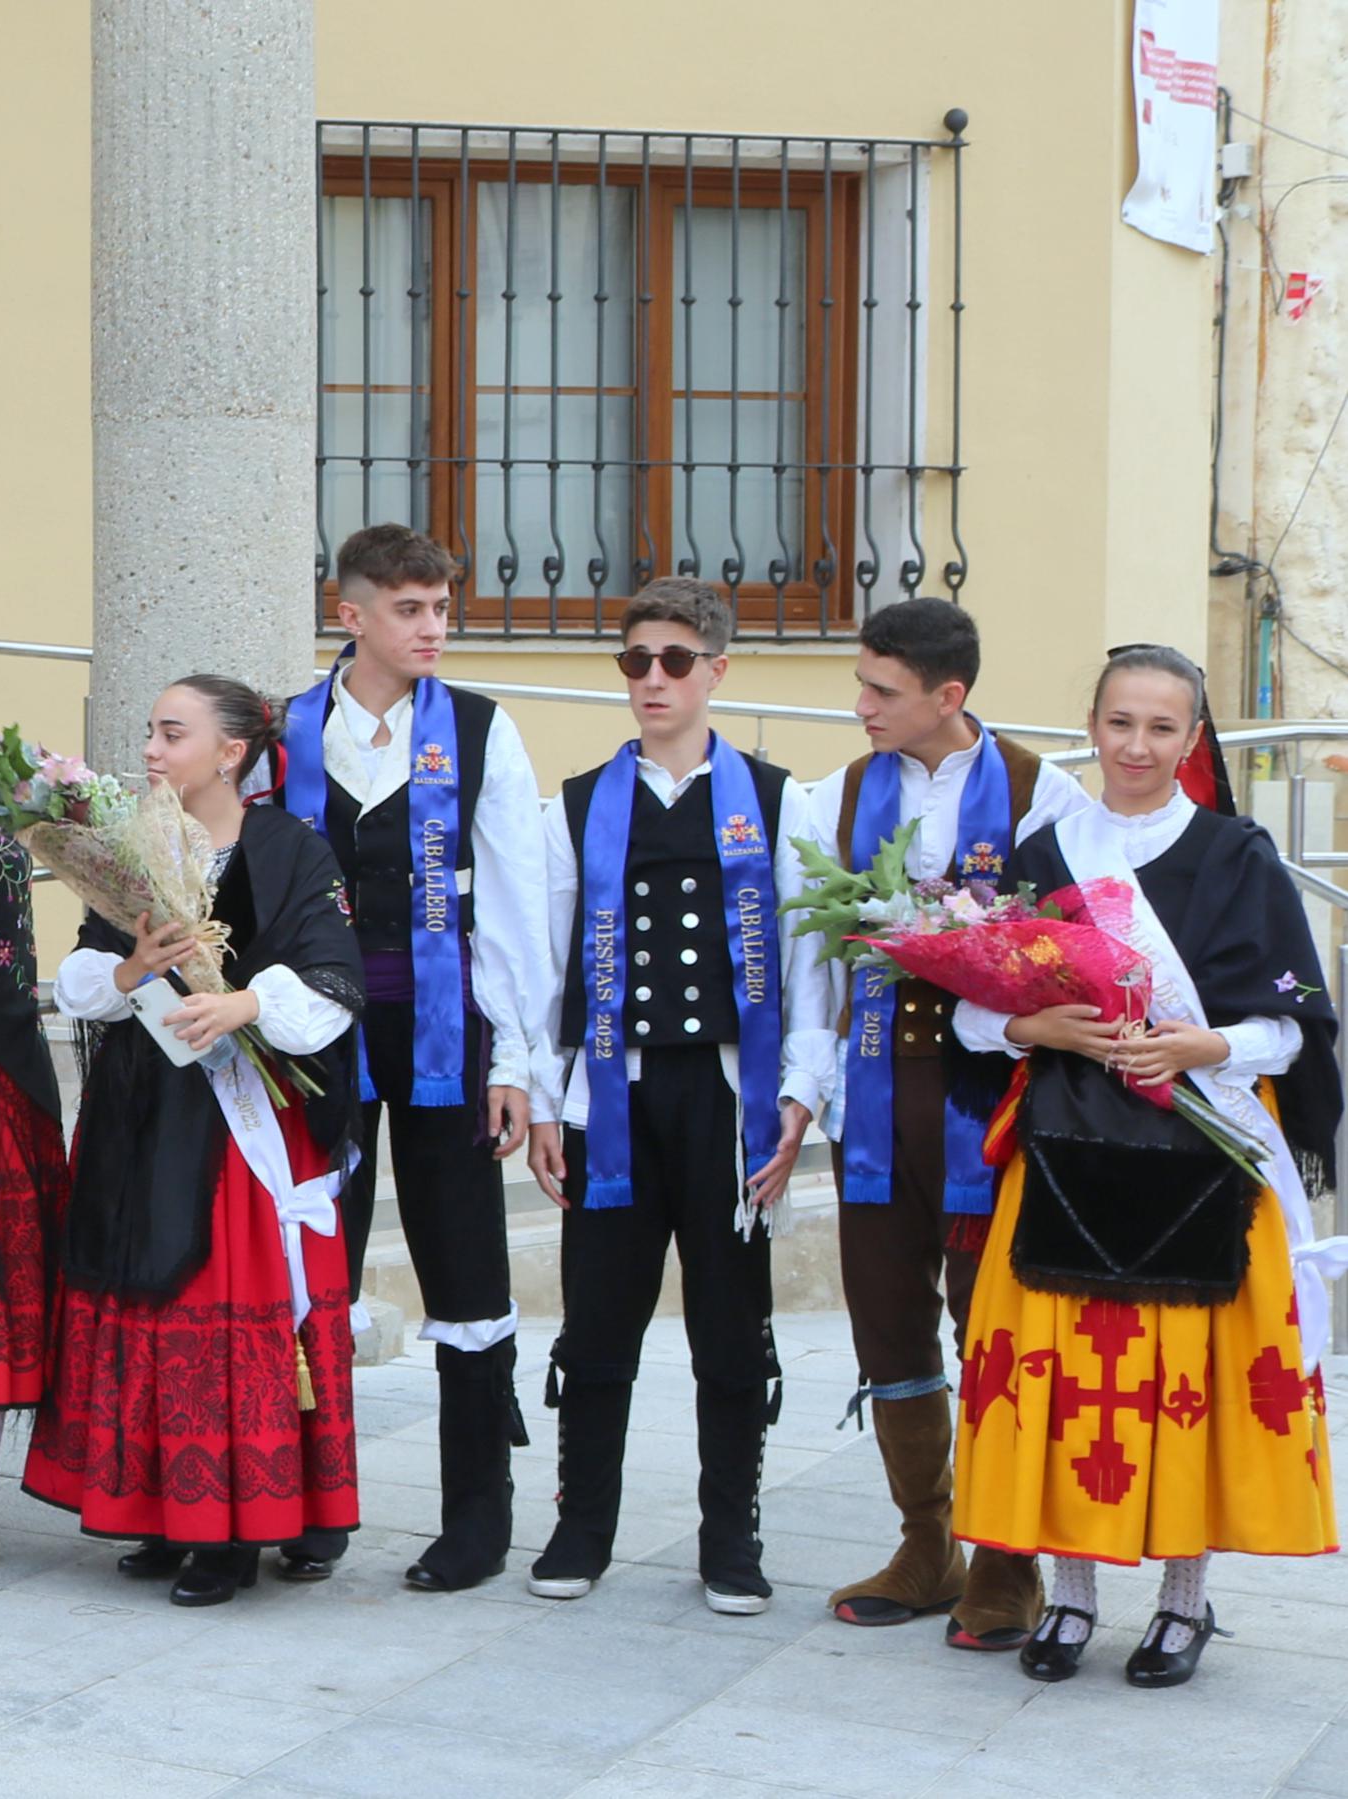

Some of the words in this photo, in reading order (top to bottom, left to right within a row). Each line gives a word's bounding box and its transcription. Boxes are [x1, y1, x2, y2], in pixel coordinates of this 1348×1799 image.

[423, 819, 447, 933] CABALLERO
[595, 909, 614, 1002] FIESTAS
[737, 887, 765, 1004] CABALLERO
[1153, 978, 1181, 1010] DE
[595, 1013, 612, 1060] 2022
[860, 1011, 881, 1057] 2022
[233, 1093, 261, 1133] 2022
